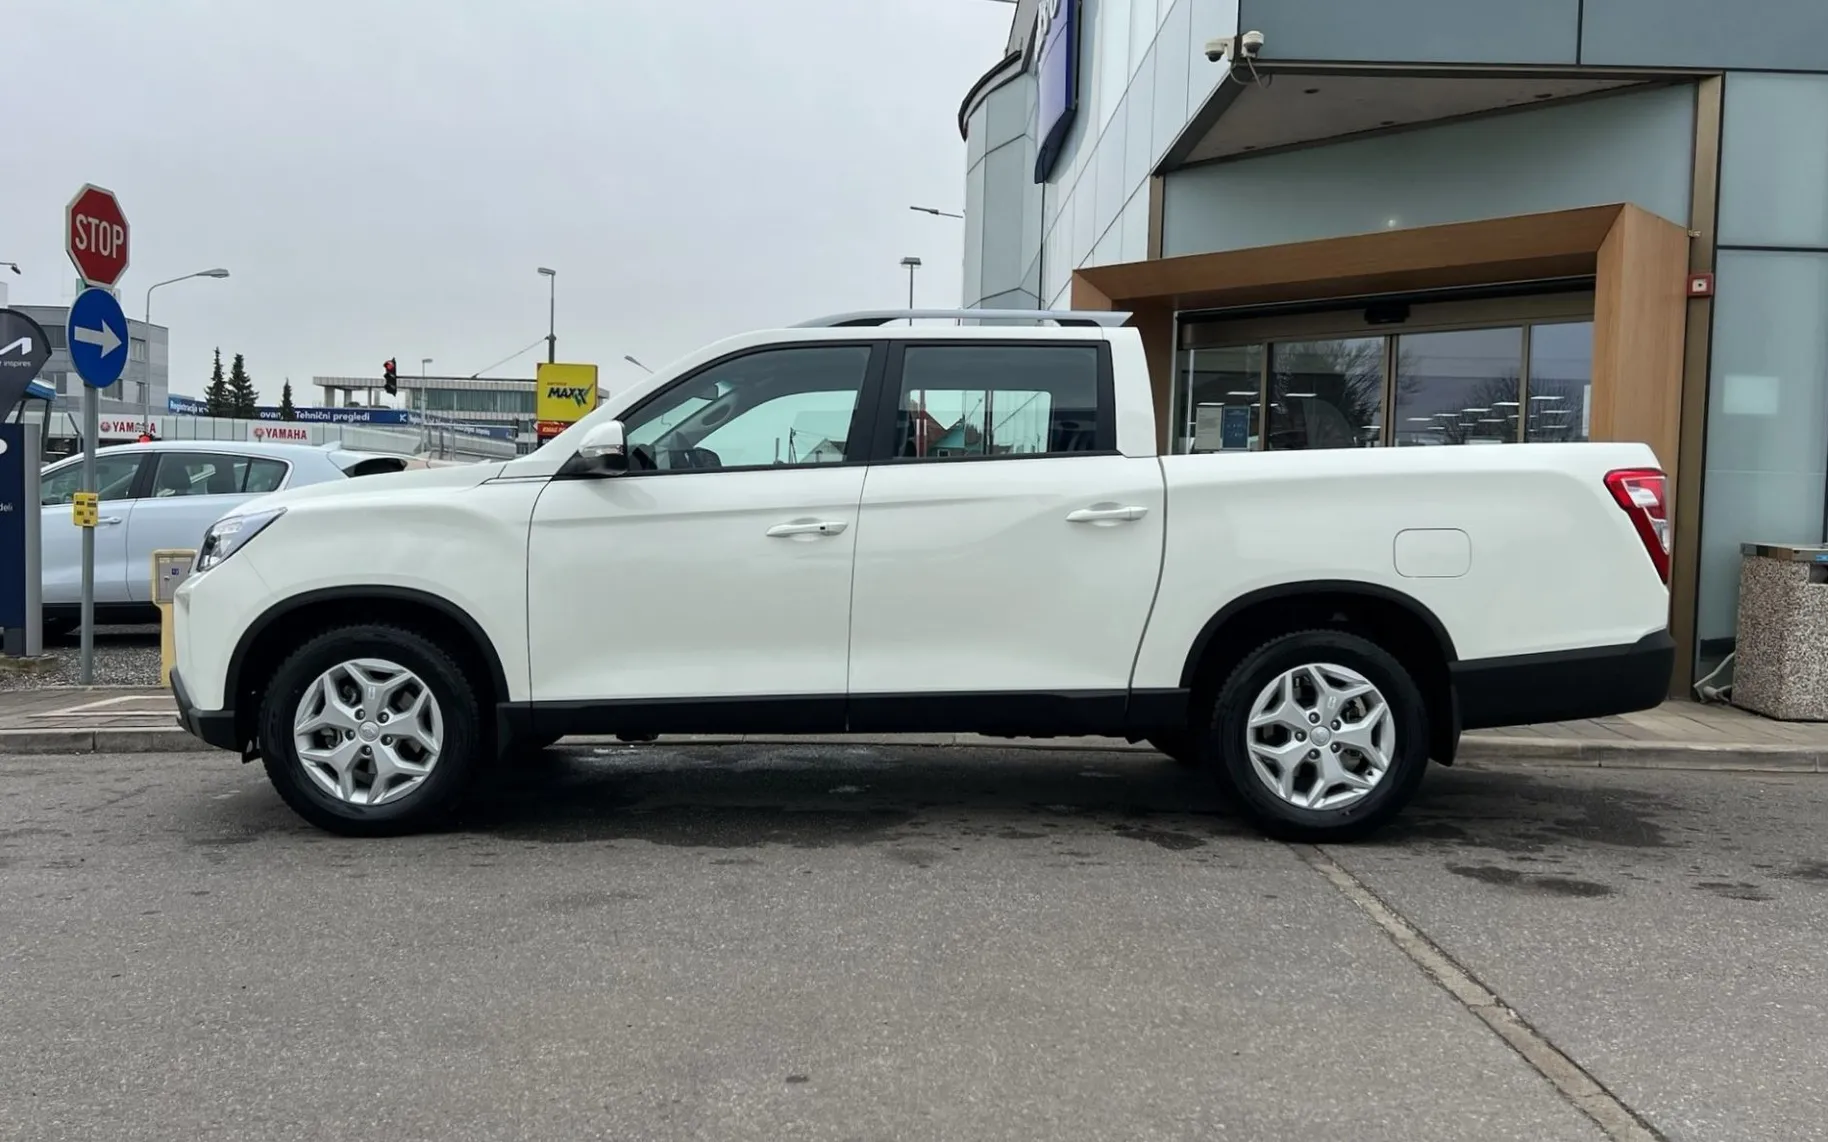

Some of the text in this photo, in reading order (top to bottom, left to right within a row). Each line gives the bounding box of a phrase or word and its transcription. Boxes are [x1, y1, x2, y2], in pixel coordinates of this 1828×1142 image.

[75, 213, 124, 258] STOP
[547, 385, 593, 407] MAXX
[294, 410, 370, 423] Tehnični pregledi
[265, 427, 308, 440] YAMAHA
